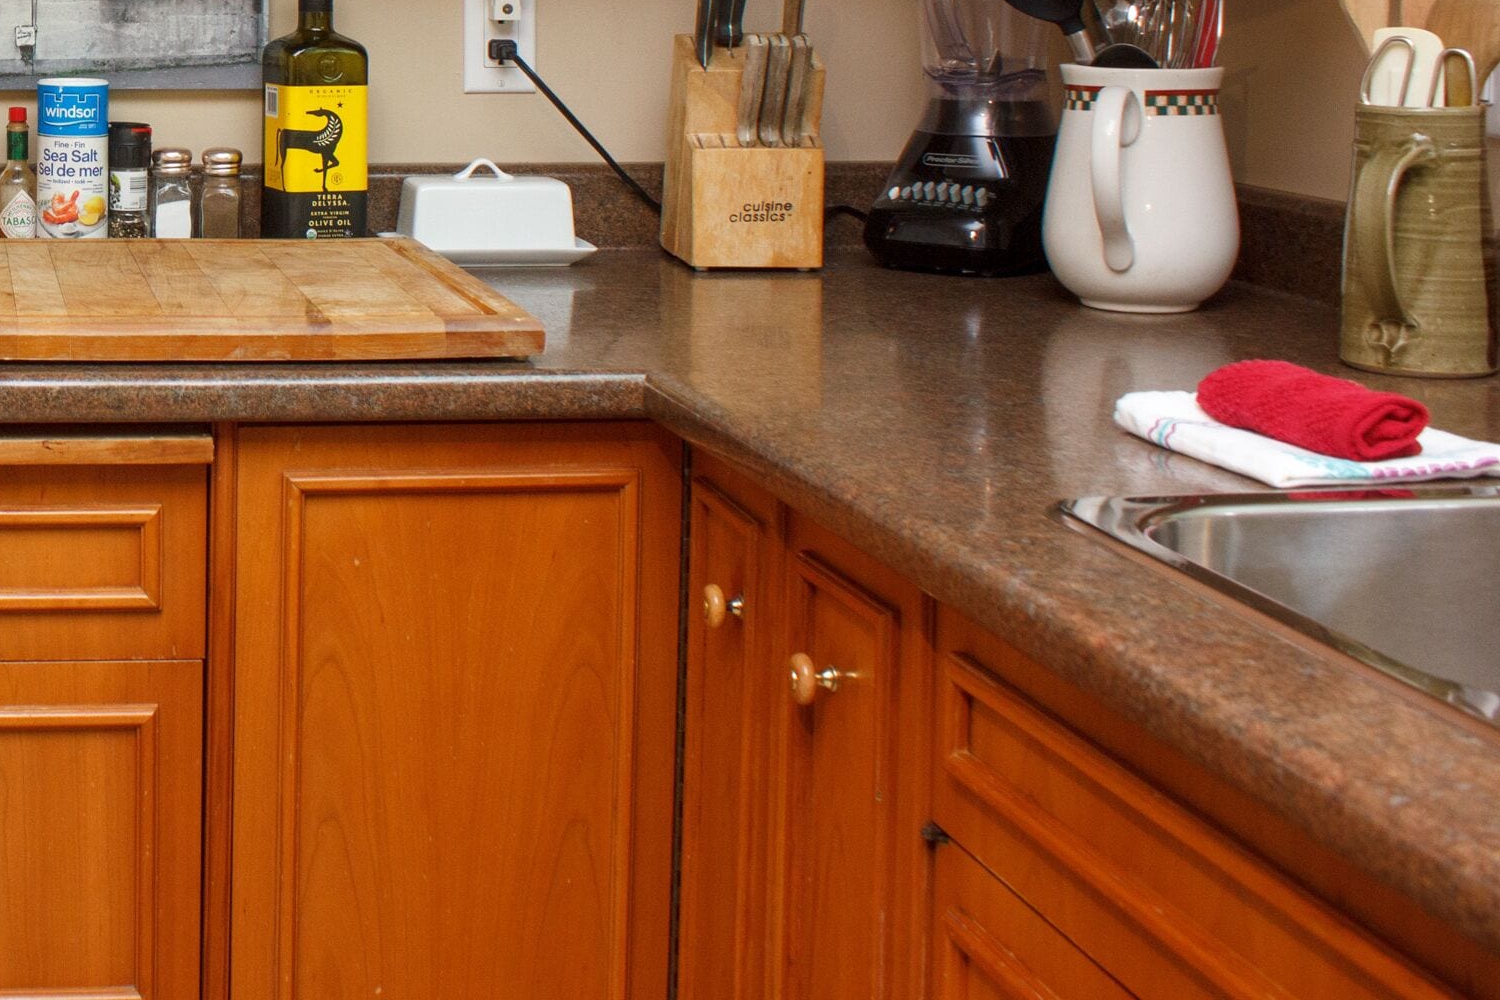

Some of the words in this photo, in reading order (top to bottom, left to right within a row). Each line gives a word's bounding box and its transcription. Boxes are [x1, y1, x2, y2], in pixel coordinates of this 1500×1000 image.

[45, 103, 97, 118] windsor
[54, 140, 69, 148] Fine
[43, 148, 68, 162] Sea
[71, 148, 98, 163] Salt
[38, 162, 54, 176] Sel
[56, 163, 76, 177] de
[79, 166, 104, 177] mer
[743, 200, 793, 212] cuisine
[308, 219, 334, 227] OLIVE
[729, 210, 786, 223] classics
